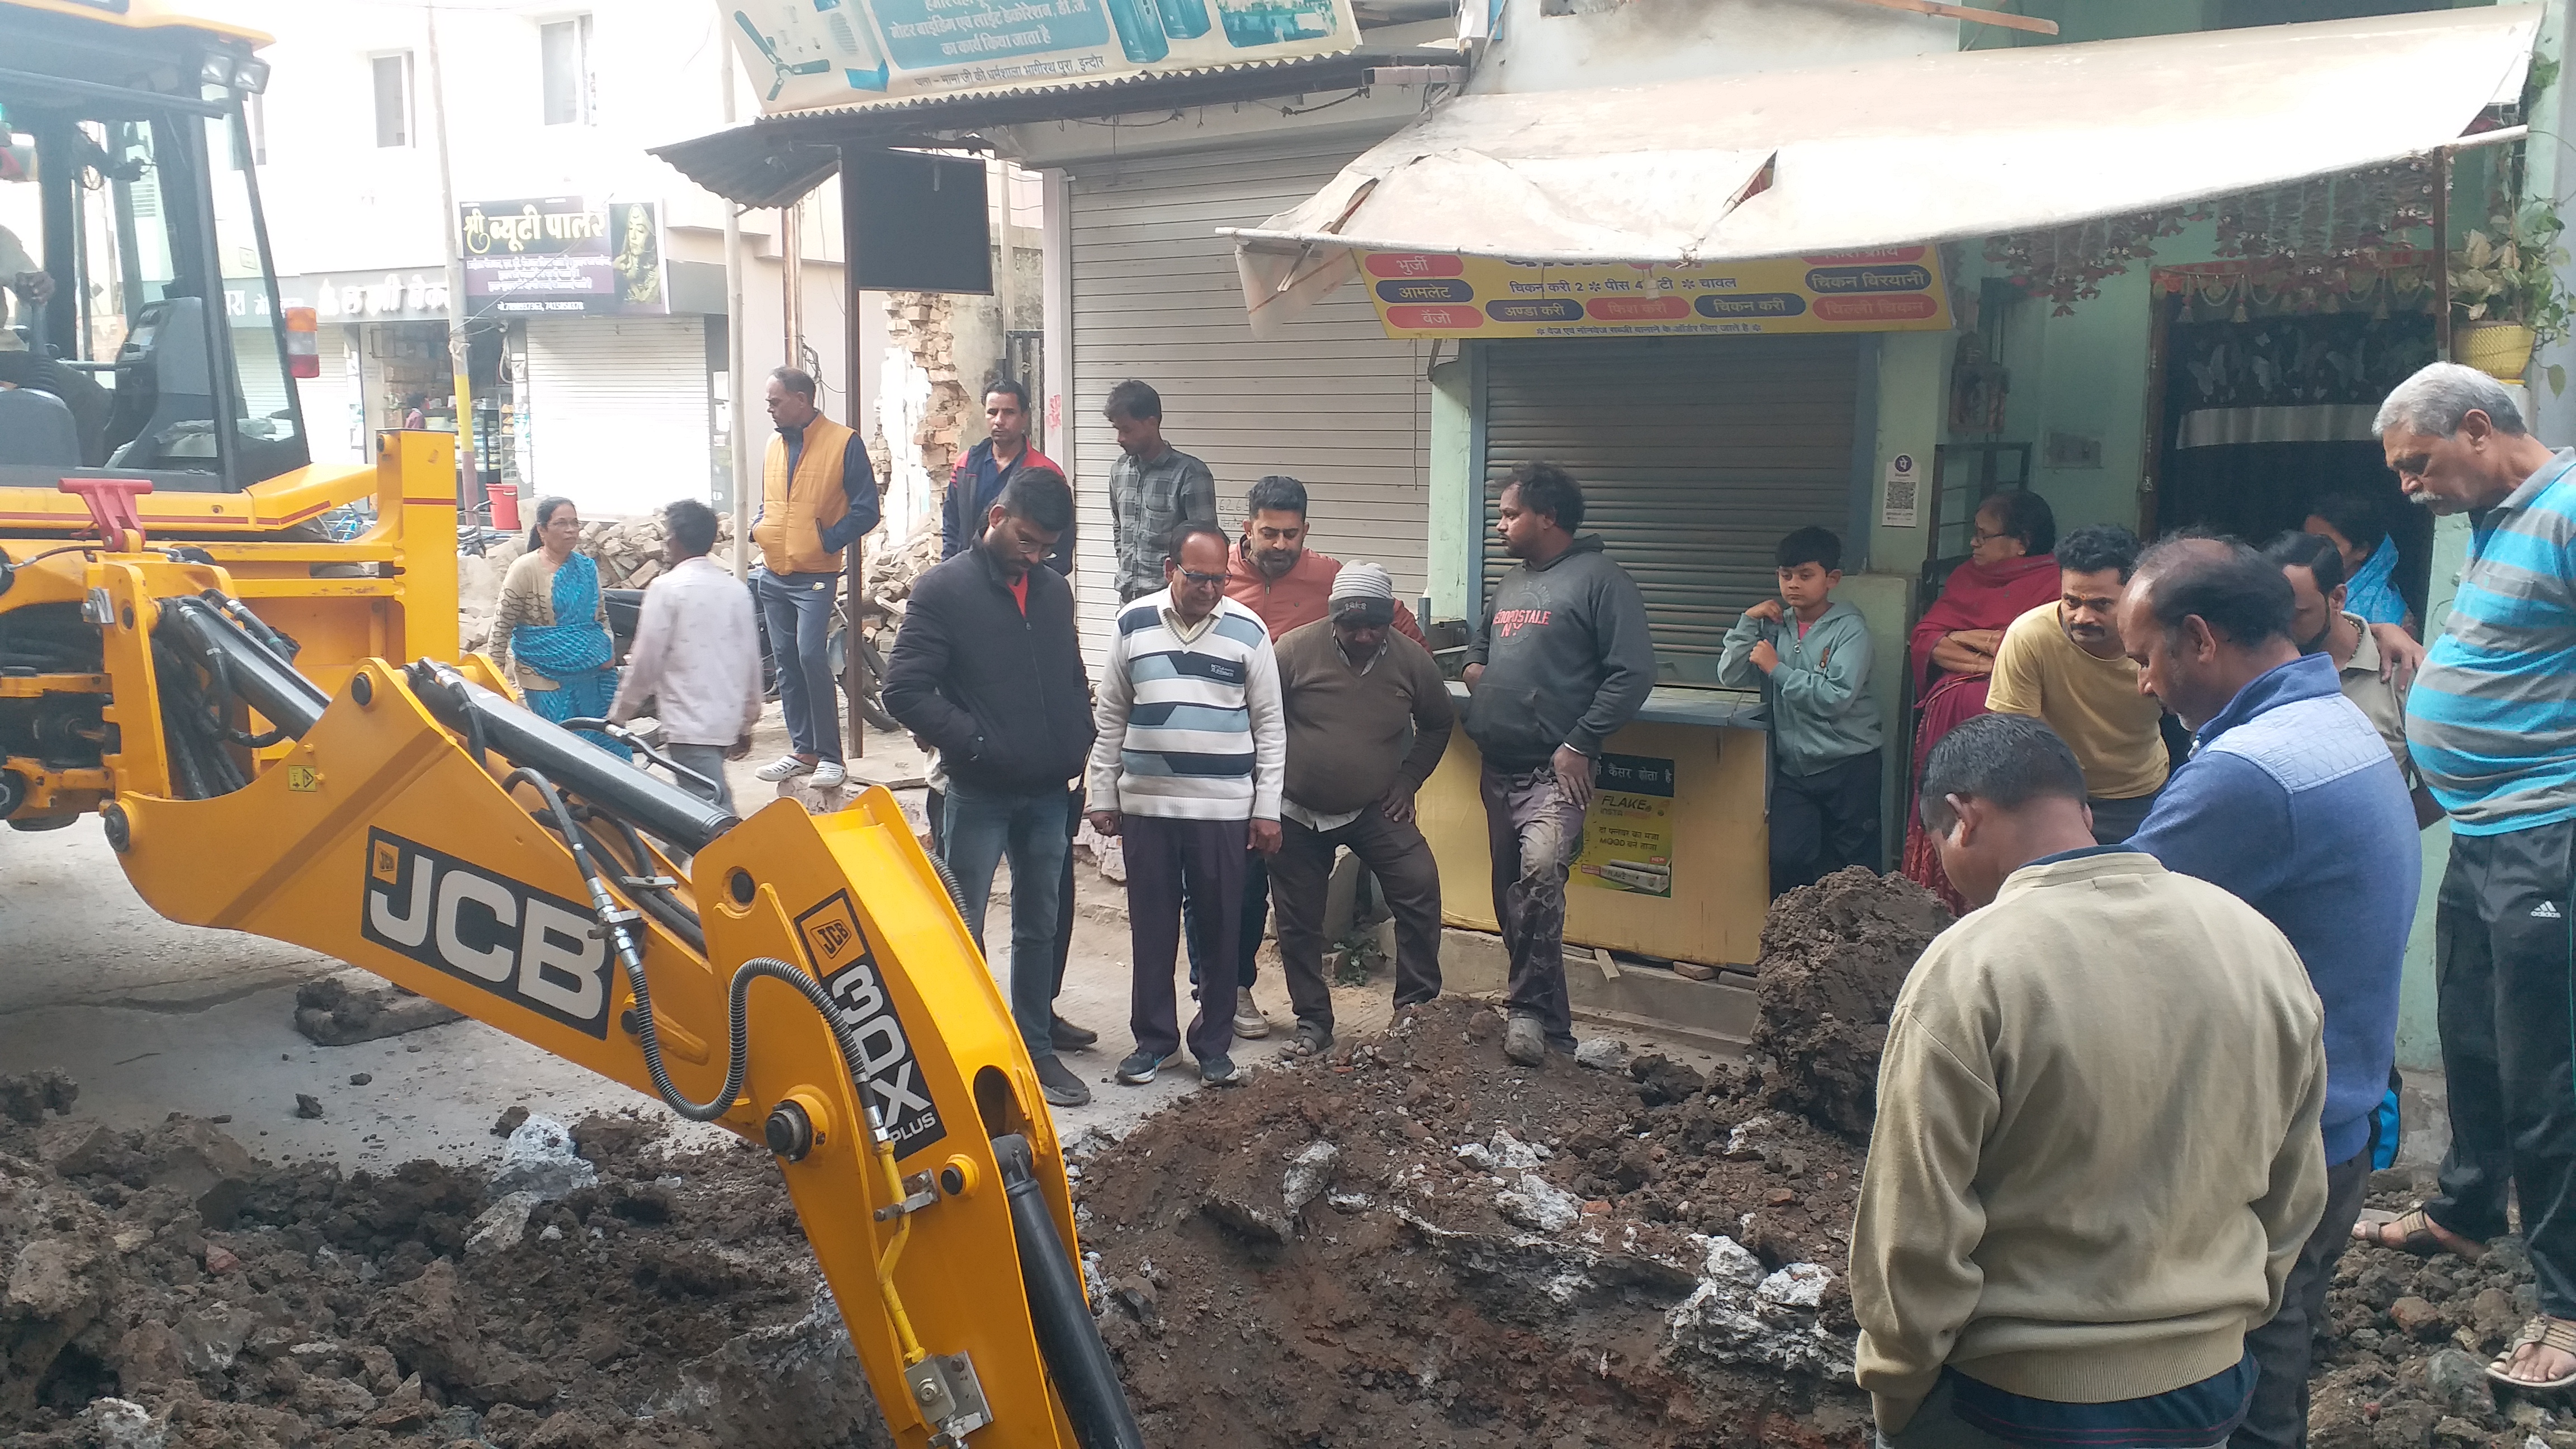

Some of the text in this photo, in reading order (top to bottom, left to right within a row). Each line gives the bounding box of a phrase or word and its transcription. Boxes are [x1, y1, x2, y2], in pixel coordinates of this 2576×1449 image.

[940, 42, 958, 55] का
[980, 32, 1011, 50] किया
[1010, 30, 1041, 46] जाता
[1038, 24, 1051, 44] है
[961, 68, 974, 84] जी
[974, 67, 987, 82] की
[987, 63, 1022, 80] धर्मशाला
[1024, 59, 1056, 75] भागीरथ
[462, 208, 490, 254] श्री
[487, 203, 542, 252] ब्यूटी
[1396, 255, 1429, 276] भुर्जी
[1509, 281, 1543, 294] चिकन
[1547, 280, 1571, 293] करी
[1574, 283, 1584, 292] 2
[1604, 278, 1630, 292] पीस
[1698, 277, 1737, 289] चावल
[1811, 273, 1857, 289] चिकन
[1398, 283, 1452, 299] आमलेट
[1505, 302, 1565, 317] अण्डा करी
[1641, 301, 1668, 315] करी
[1713, 297, 1786, 313] चिकन करी
[1664, 768, 1673, 784] है
[1602, 795, 1647, 810] FLAKE
[1599, 837, 1626, 846] MOOD
[370, 854, 605, 1020] JCB
[817, 919, 850, 955] JCB
[832, 964, 932, 1128] 3DX
[889, 1112, 936, 1146] PLUS
